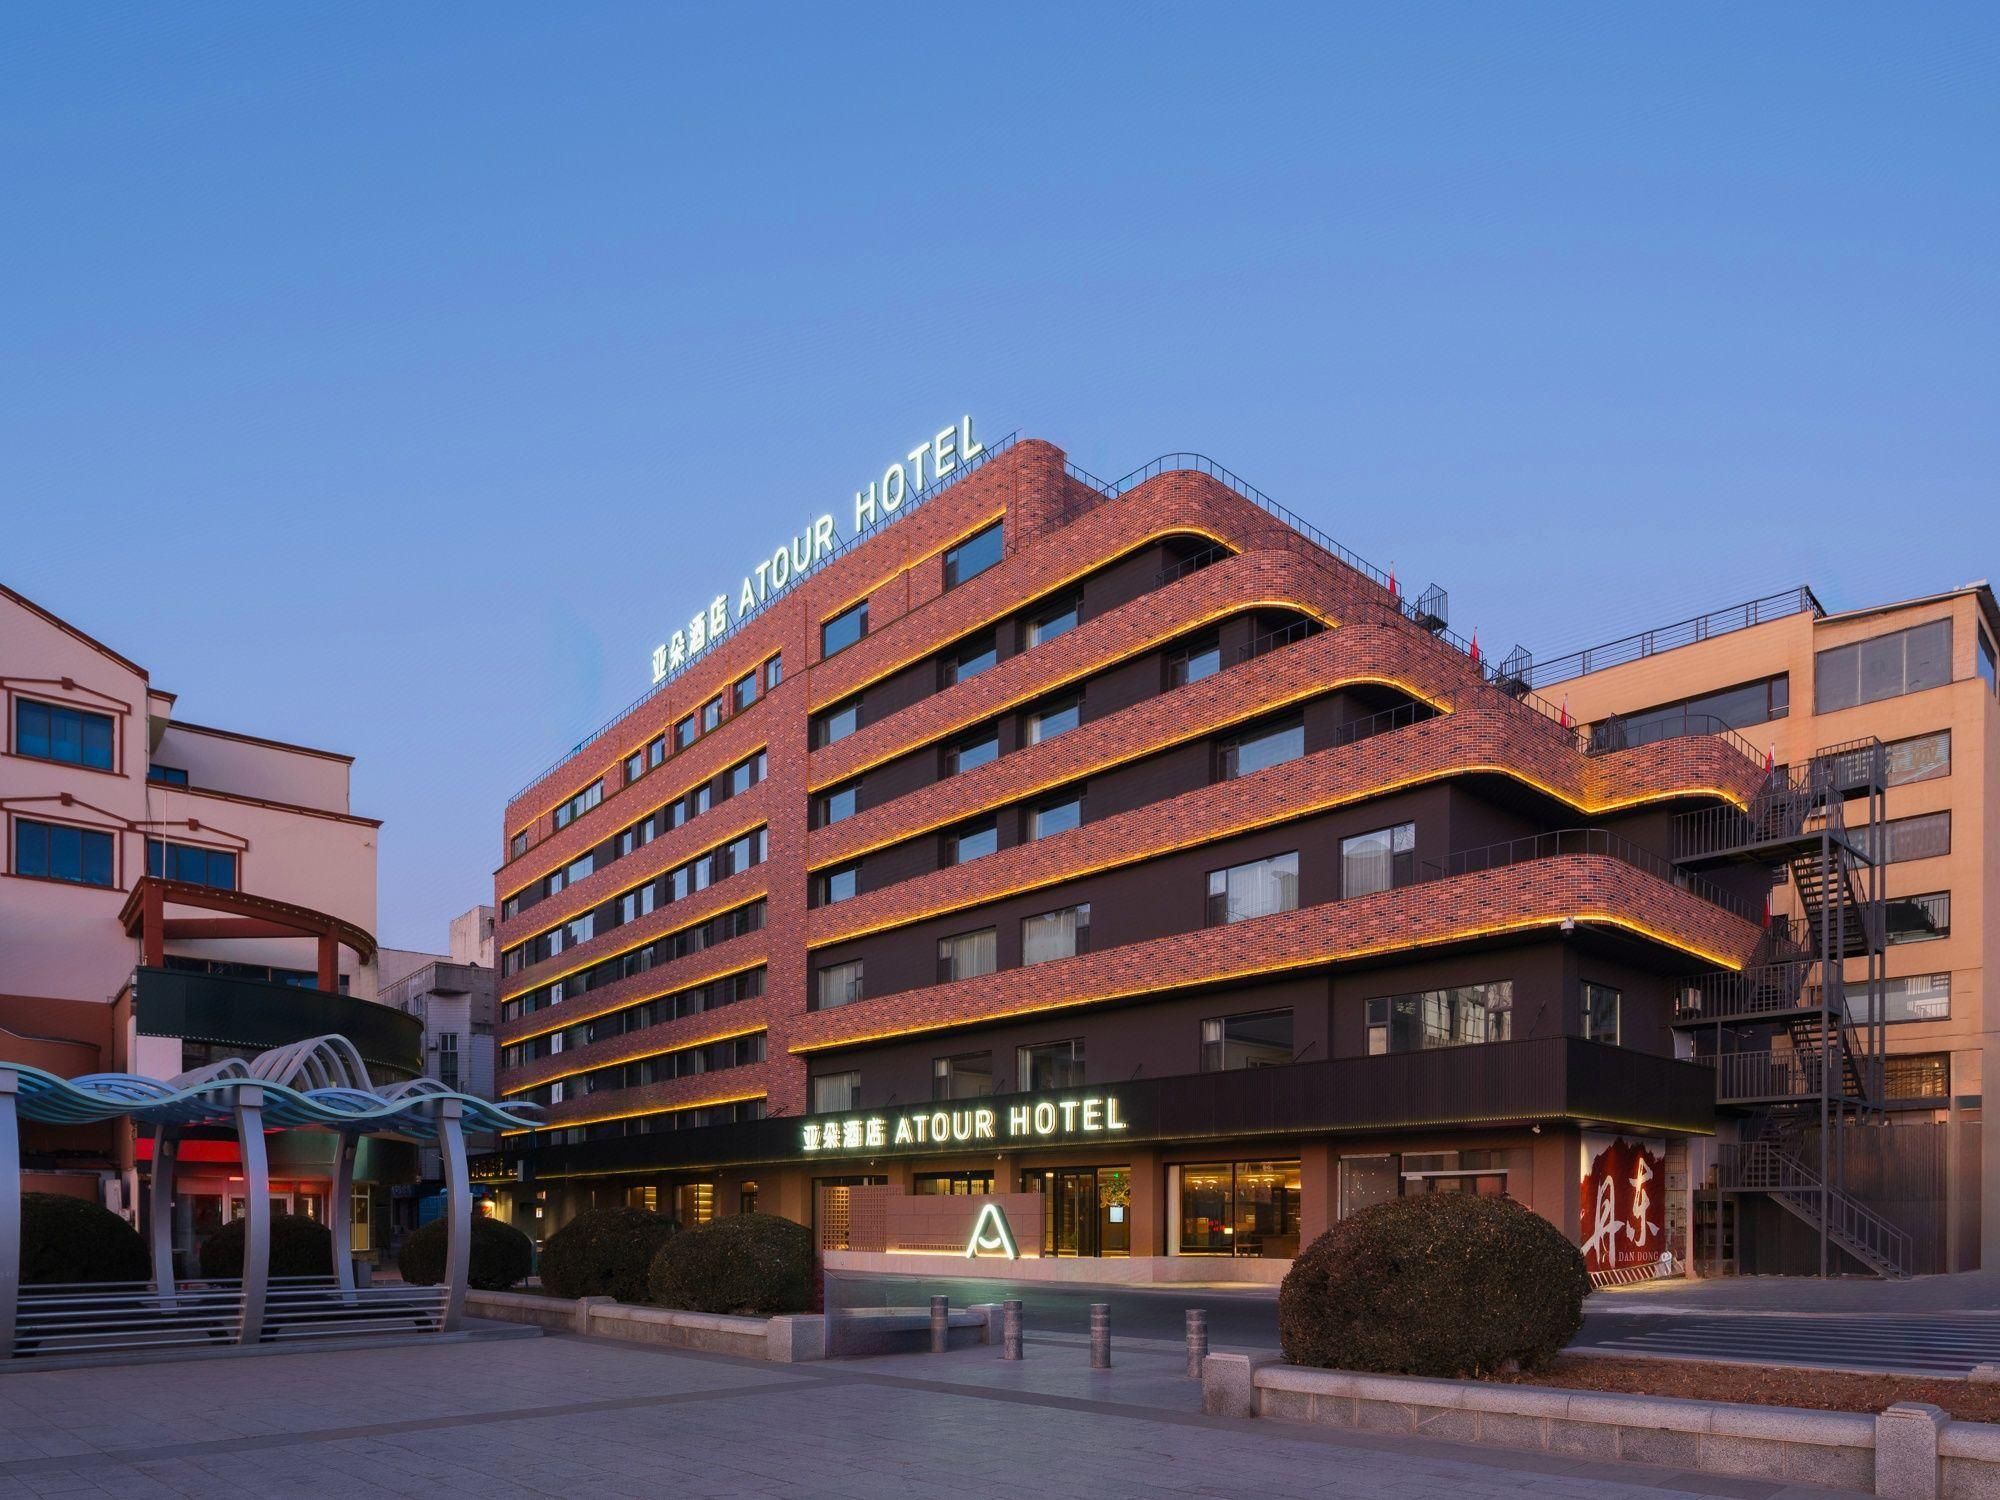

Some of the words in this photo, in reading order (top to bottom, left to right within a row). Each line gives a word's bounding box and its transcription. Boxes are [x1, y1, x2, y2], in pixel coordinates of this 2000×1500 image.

[652, 594, 728, 684] 亚朵酒店
[738, 513, 835, 618] ATOUR
[855, 415, 984, 533] HOTEL
[803, 1118, 887, 1150] 亚朵酒店
[894, 1109, 995, 1143] ATOUR
[1010, 1097, 1127, 1136] HOTEL
[1618, 1251, 1635, 1262] DAN
[1637, 1251, 1659, 1262] DONG
